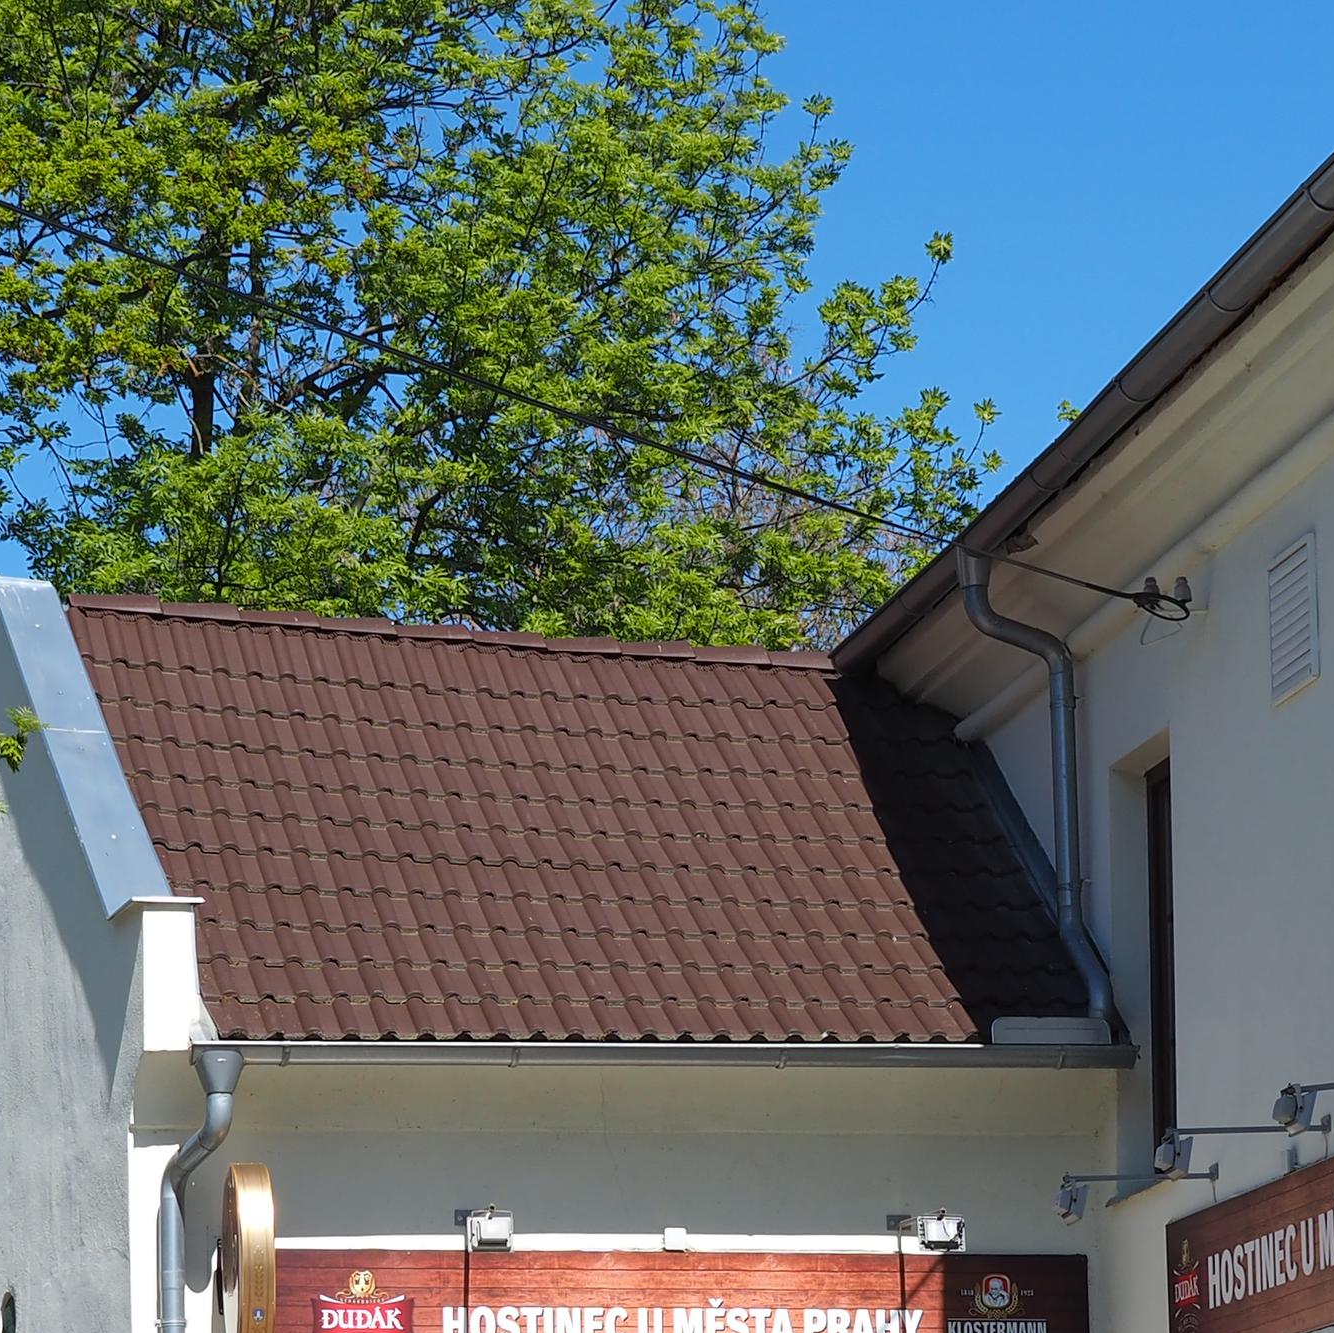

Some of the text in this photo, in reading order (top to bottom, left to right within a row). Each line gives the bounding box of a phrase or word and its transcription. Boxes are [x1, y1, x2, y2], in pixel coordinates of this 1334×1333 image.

[1207, 1223, 1298, 1310] HOSTINEC
[1300, 1217, 1316, 1277] U
[1174, 1273, 1200, 1303] DUDÁK
[321, 1306, 404, 1330] DUDÁK
